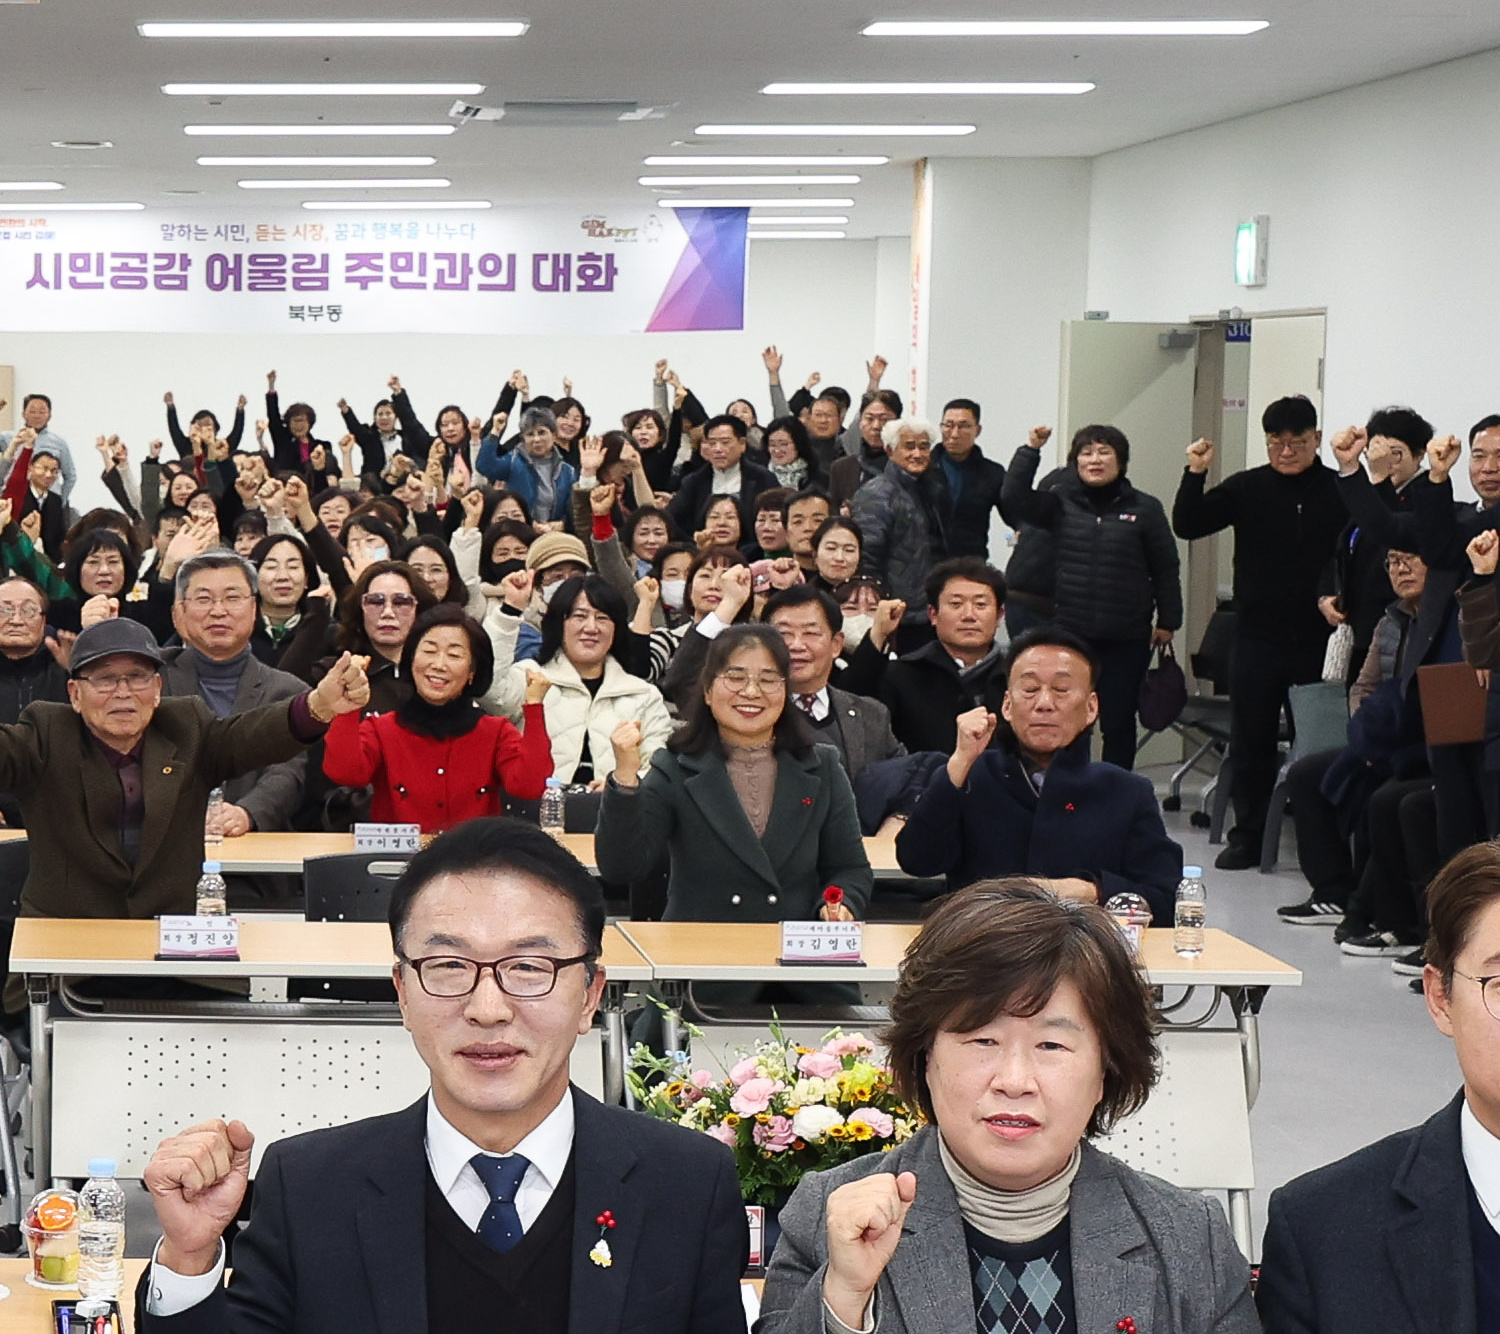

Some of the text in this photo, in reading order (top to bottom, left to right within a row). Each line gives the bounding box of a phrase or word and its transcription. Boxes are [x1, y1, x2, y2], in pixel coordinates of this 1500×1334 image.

[160, 223, 208, 242] 말하는
[255, 224, 286, 242] 듣는
[335, 223, 367, 240] 꿈과
[372, 223, 420, 240] 행복을
[426, 221, 476, 241] 나누다
[26, 252, 619, 293] 시민공감 어울림 주민과의 대화
[288, 305, 343, 324] 북부동
